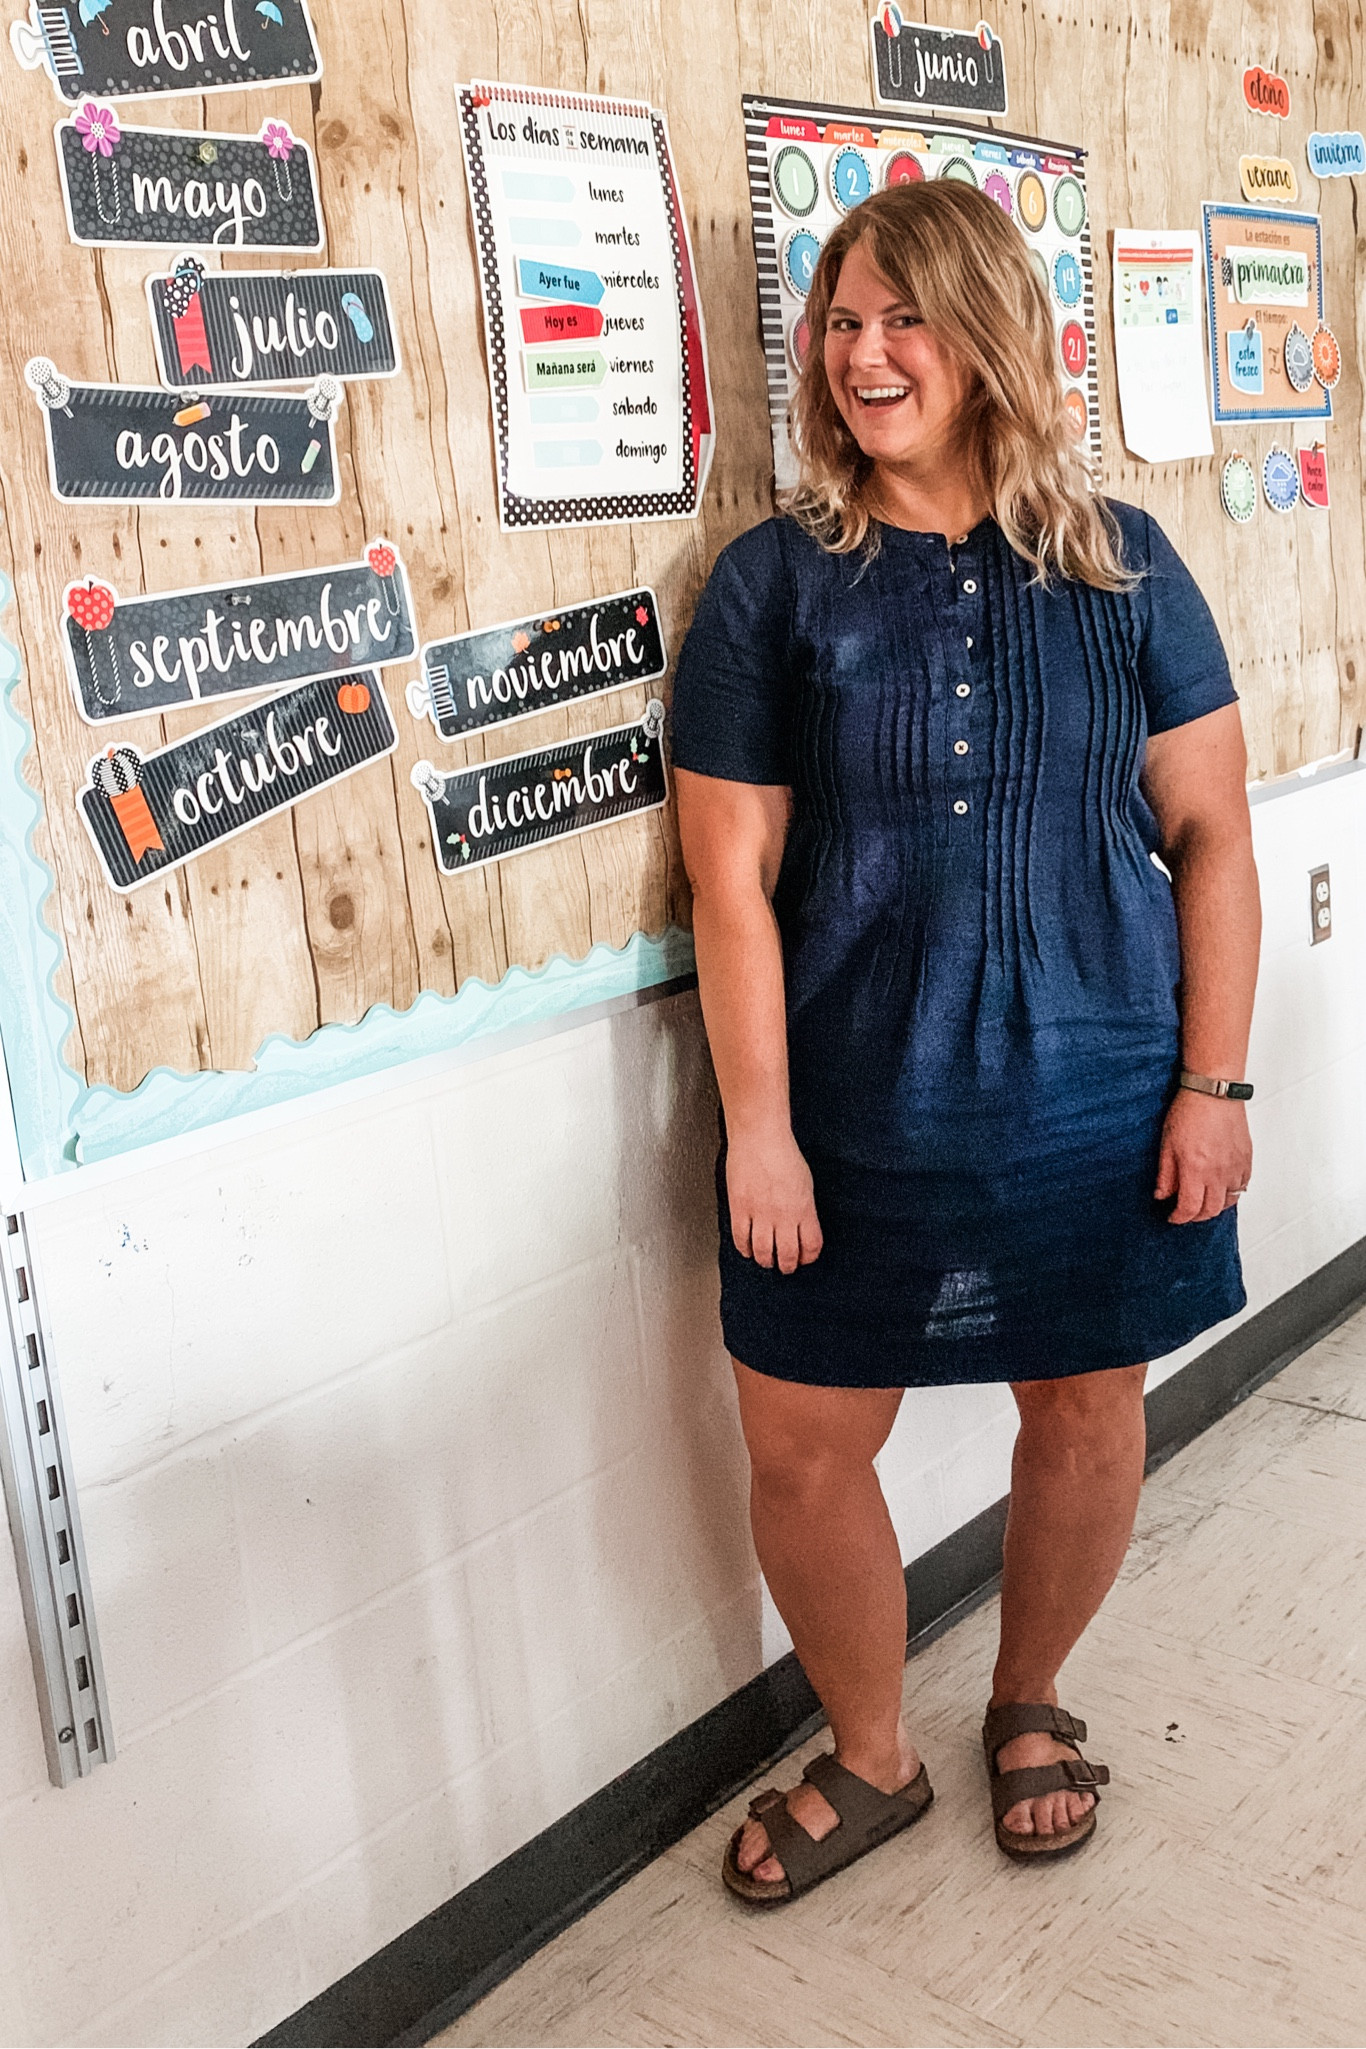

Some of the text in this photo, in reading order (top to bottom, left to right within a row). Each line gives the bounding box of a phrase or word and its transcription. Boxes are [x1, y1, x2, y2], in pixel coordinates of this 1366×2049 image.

[126, 0, 251, 71] abril
[913, 37, 978, 98] junio
[487, 112, 560, 147] Los días
[565, 128, 574, 138] de
[780, 120, 806, 137] lunes
[833, 128, 865, 143] martes
[580, 130, 649, 156] semana
[1314, 143, 1362, 165] invierno
[792, 168, 800, 196] 1
[847, 168, 861, 196] 2
[1247, 166, 1291, 190] verano
[588, 181, 624, 203] lunes
[1029, 191, 1038, 216] 6
[132, 172, 267, 245] mayo
[1065, 196, 1075, 220] 7
[595, 226, 640, 246] martes
[1245, 228, 1253, 242] La
[1283, 235, 1290, 246] es
[801, 250, 814, 278] 8
[539, 271, 580, 291] Ayer fue
[601, 270, 659, 290] miércoles
[1062, 267, 1076, 293] 14
[1237, 260, 1305, 298] primavera
[544, 316, 577, 332] Hoy es
[603, 314, 645, 337] jueves
[1255, 310, 1262, 323] El
[229, 293, 338, 379] julio
[1068, 338, 1081, 362] 21
[537, 359, 596, 376] Mañana será
[609, 357, 654, 374] viernes
[612, 395, 658, 416] sábado
[116, 413, 281, 499] agosto
[616, 438, 667, 464] domingo
[129, 582, 392, 700] septiembre
[466, 612, 645, 710] noviembre
[172, 714, 342, 827] octubre
[467, 745, 639, 840] diciembre
